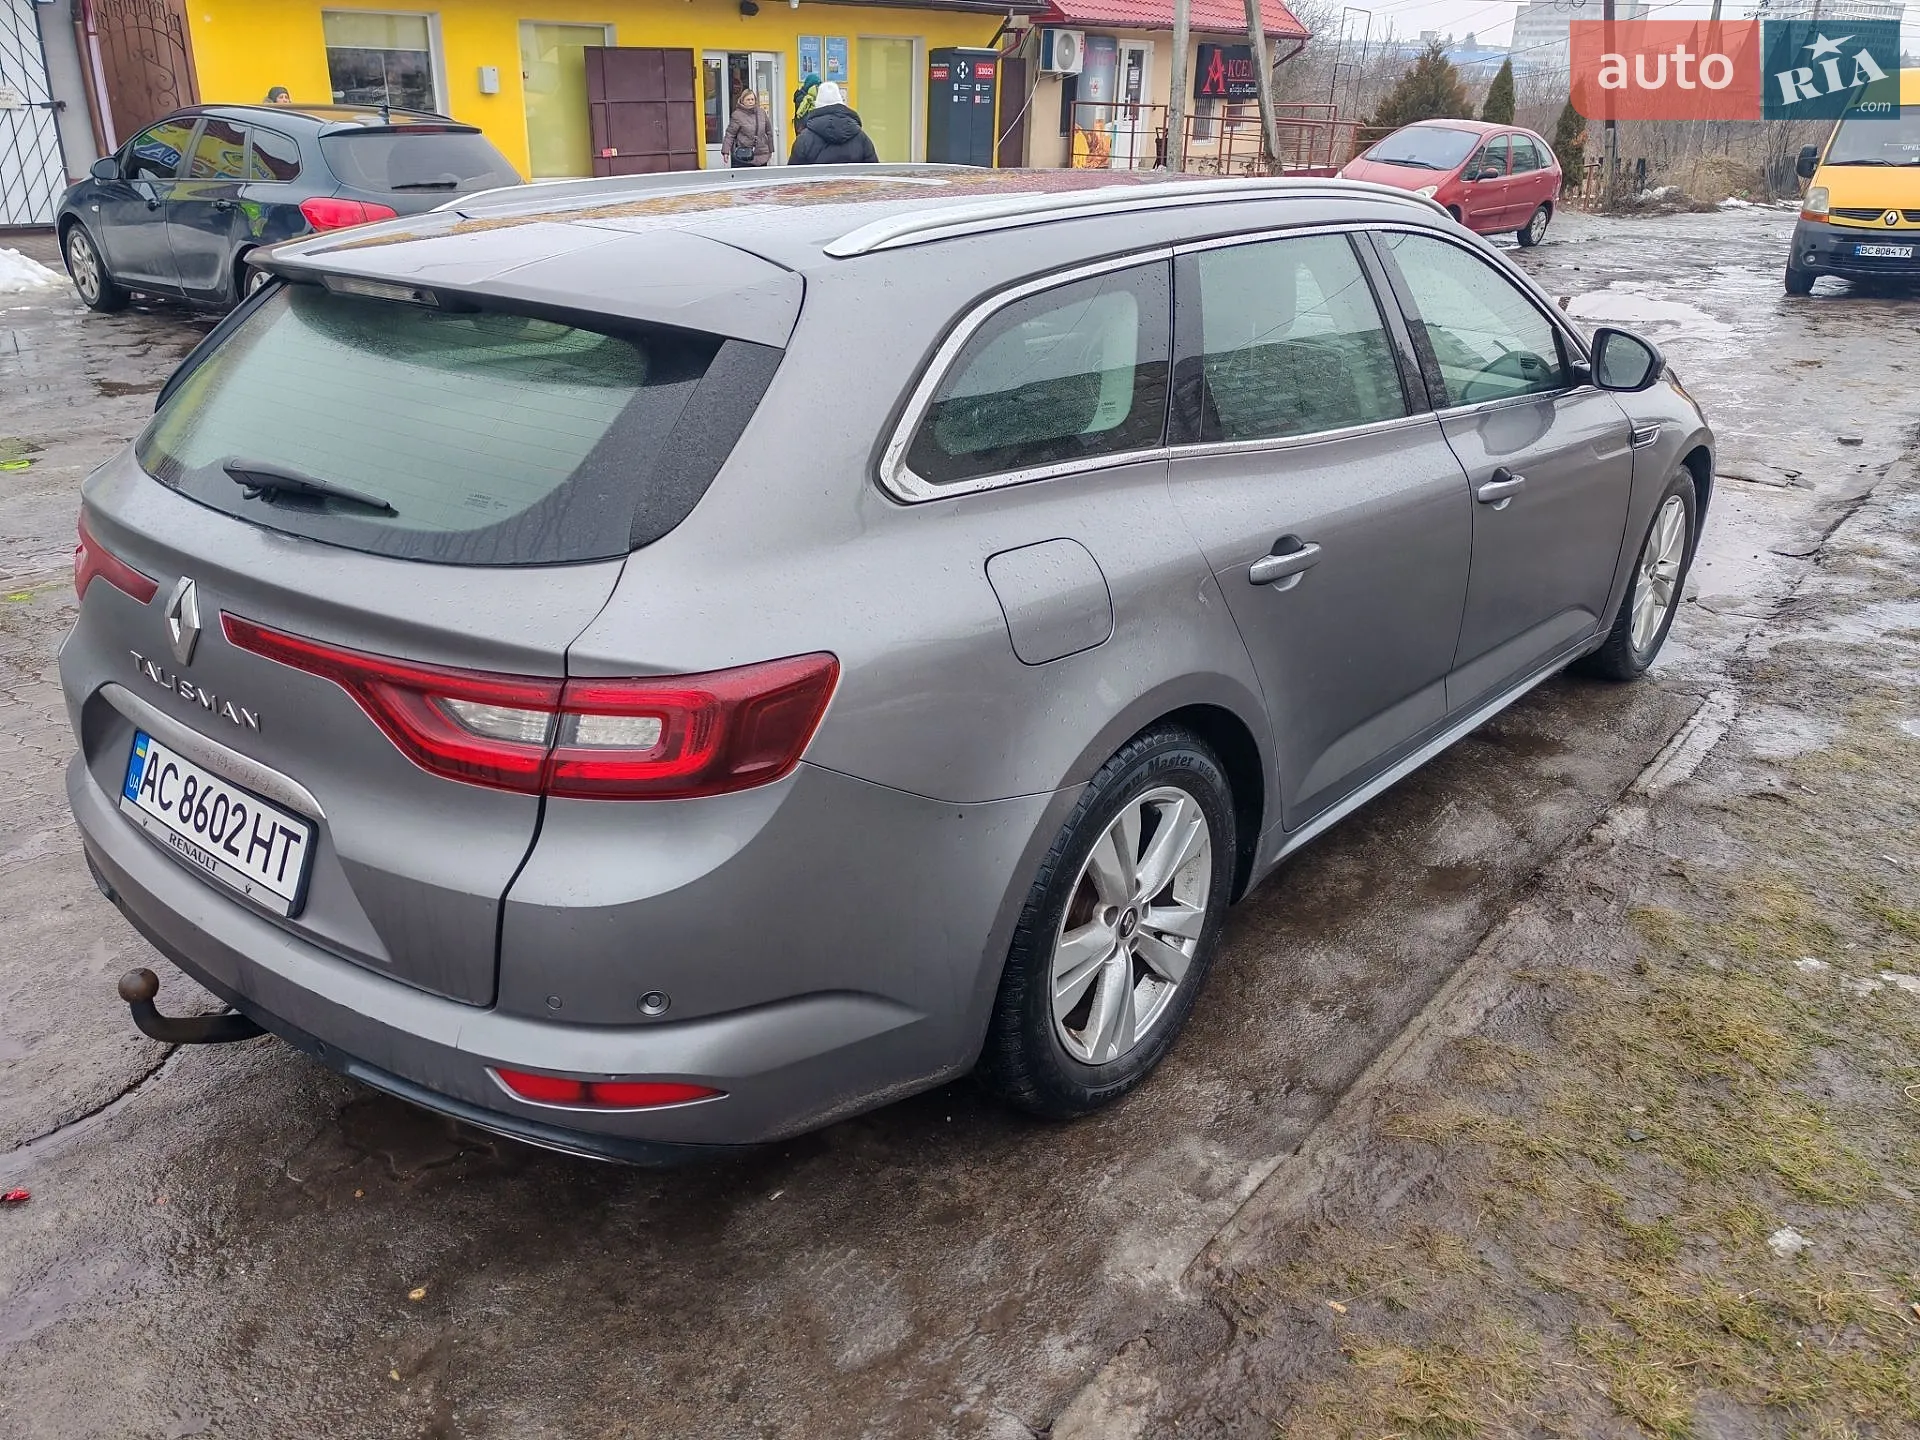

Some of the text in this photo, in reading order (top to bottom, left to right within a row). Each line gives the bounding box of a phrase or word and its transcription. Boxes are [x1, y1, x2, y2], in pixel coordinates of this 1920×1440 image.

[1861, 247, 1912, 257] BC 8084 TX
[130, 650, 262, 733] TALISMAN
[129, 775, 139, 792] UA
[140, 752, 301, 882] AC 8602 HT
[169, 832, 220, 873] RENAULT
